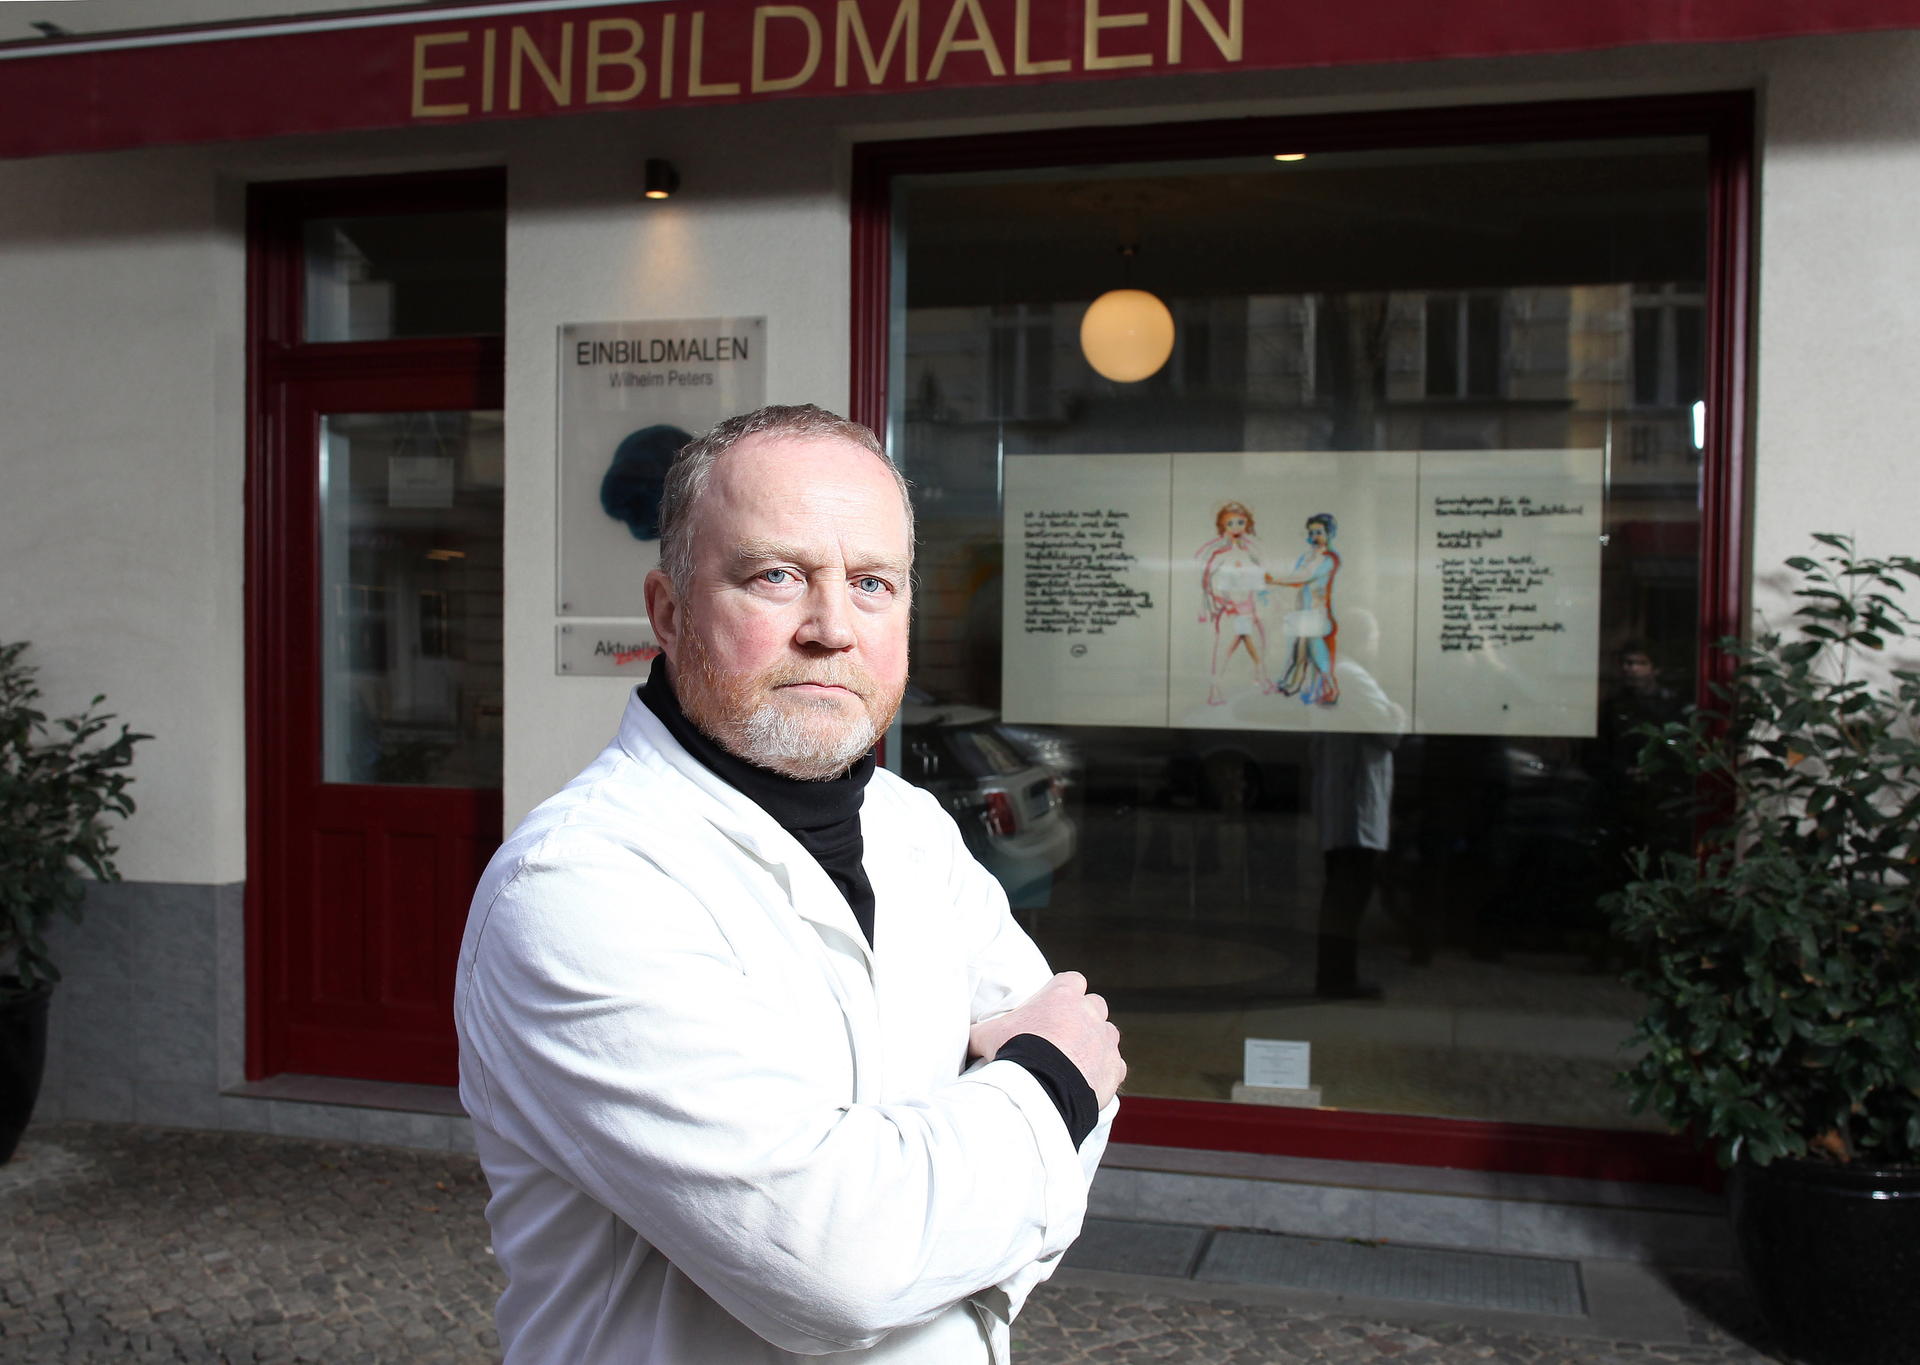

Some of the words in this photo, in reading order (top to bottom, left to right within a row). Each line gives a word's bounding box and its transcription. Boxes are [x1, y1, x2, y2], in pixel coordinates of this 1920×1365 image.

[411, 0, 1243, 118] EINBILDMALEN
[576, 337, 749, 366] EINBILDMALEN
[609, 371, 664, 387] Wilhelm
[667, 369, 714, 386] Peters
